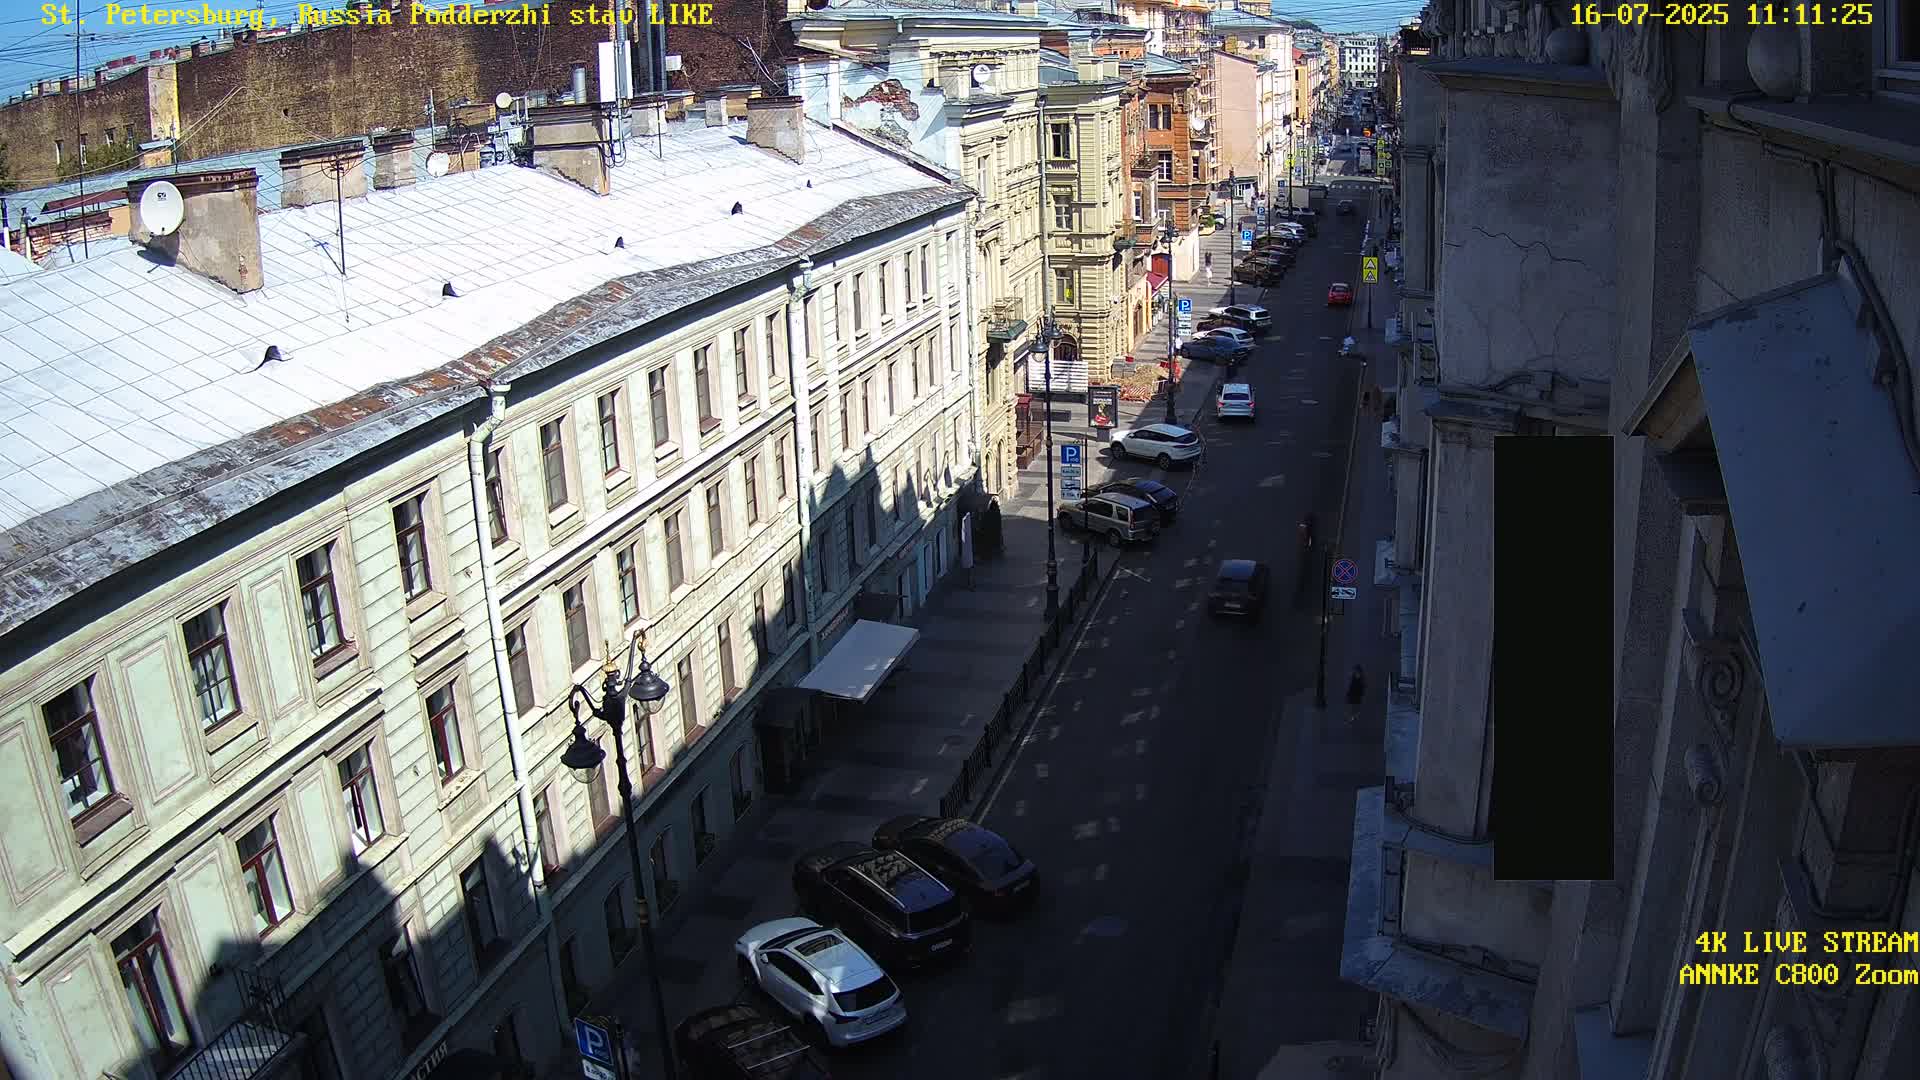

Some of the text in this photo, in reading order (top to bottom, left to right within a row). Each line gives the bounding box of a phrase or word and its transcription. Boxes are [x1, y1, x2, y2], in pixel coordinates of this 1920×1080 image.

[1066, 447, 1077, 462] P
[584, 1025, 604, 1055] P
[409, 1040, 449, 1080] СТИЯ
